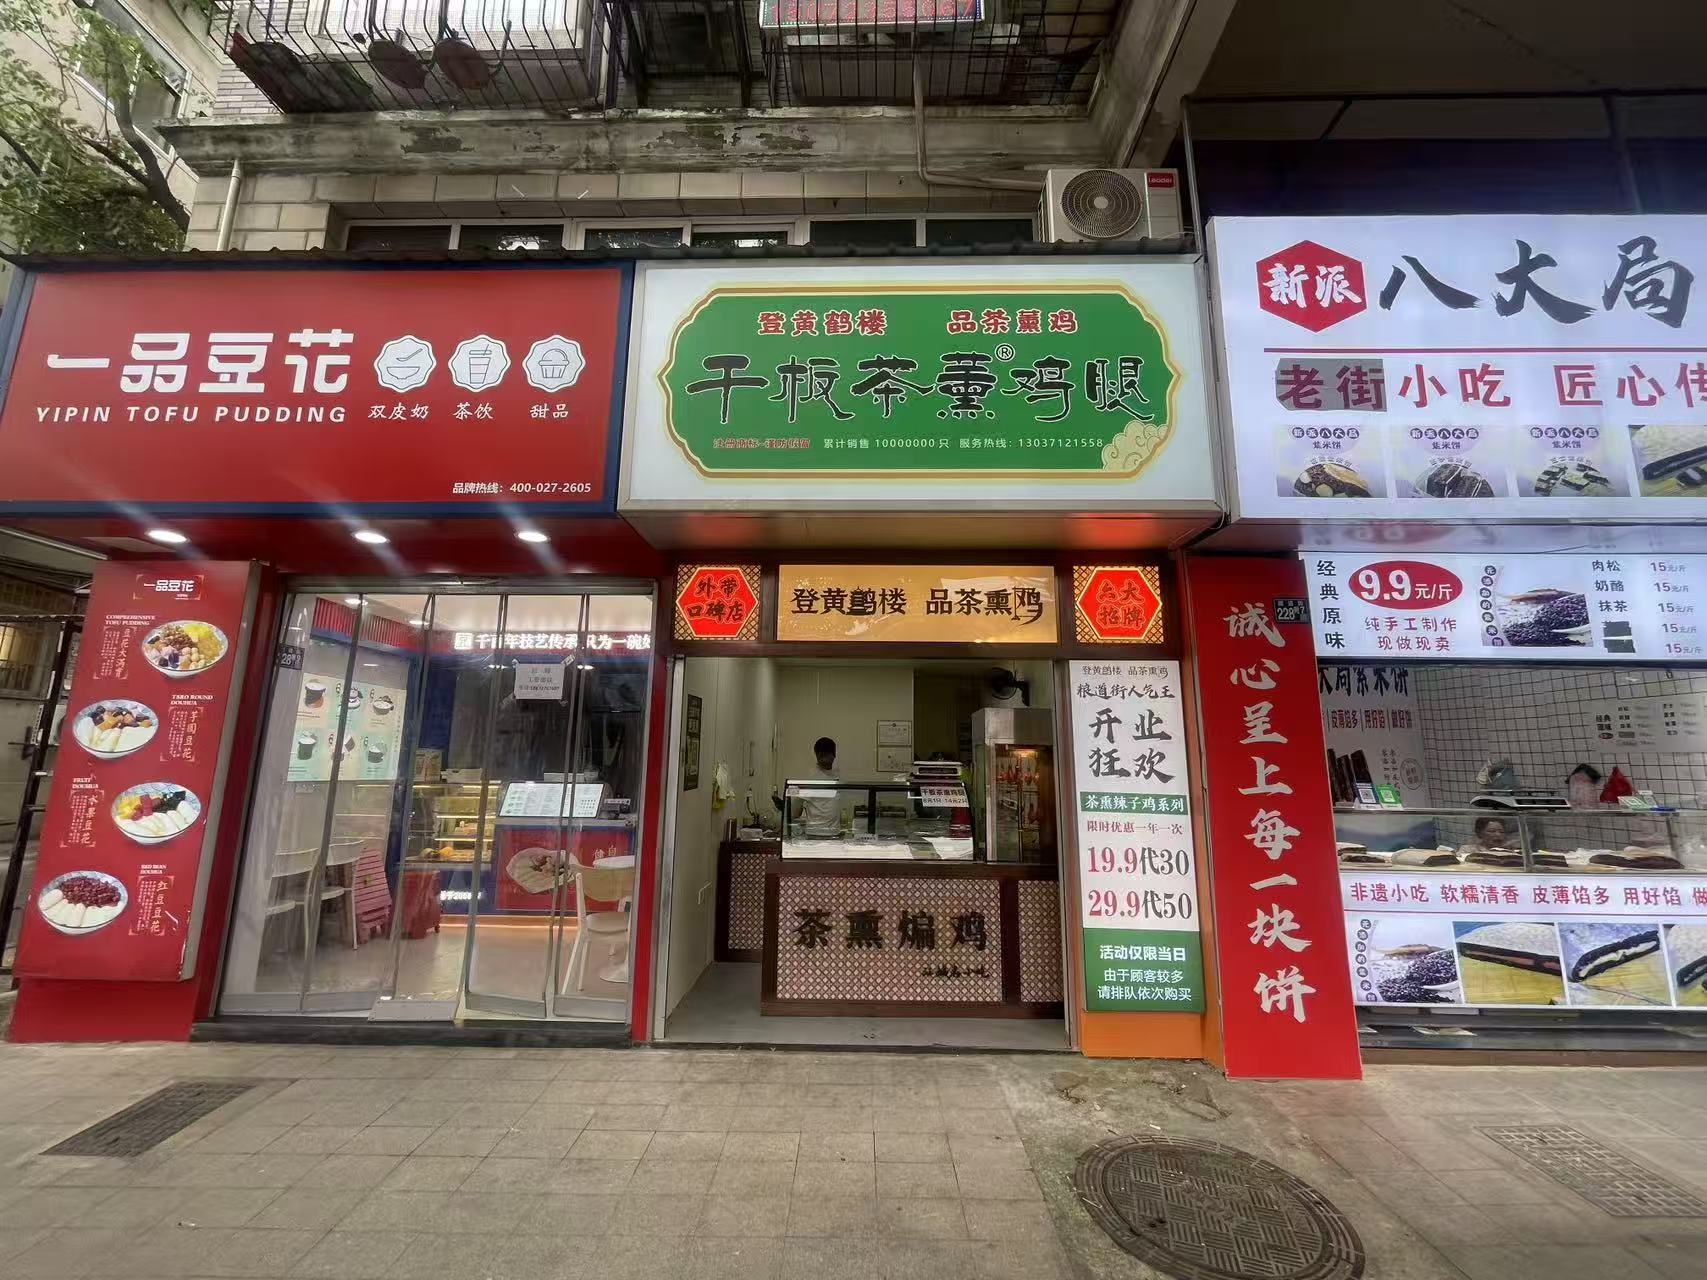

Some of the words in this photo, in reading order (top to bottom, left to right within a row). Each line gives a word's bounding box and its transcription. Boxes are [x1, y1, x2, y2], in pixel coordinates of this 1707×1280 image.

[1262, 263, 1362, 308] 新派
[1379, 235, 1694, 328] 八大局
[757, 308, 888, 336] 登黄鹤楼
[46, 328, 354, 394] 一品豆花
[1276, 362, 1512, 410] 老街小吃
[36, 406, 110, 423] YIPIN
[126, 406, 199, 423] TOFU
[215, 406, 346, 424] PUDDING
[367, 402, 429, 420] 双皮奶
[453, 402, 494, 420] 茶饮
[530, 403, 569, 419] 甜品
[1592, 560, 1620, 572] 肉松
[144, 580, 195, 591] 一品豆花
[696, 576, 738, 598] 外带
[1595, 580, 1624, 592] 奶酪
[687, 600, 744, 621] 口碑店
[1317, 560, 1345, 649] 经典原味
[1598, 601, 1628, 612] 抹茶
[1099, 605, 1143, 627] 招牌
[1365, 616, 1457, 632] 纯手工制作
[1378, 635, 1450, 651] 现做现卖
[1077, 682, 1175, 699] 粮道街人气王
[1089, 708, 1172, 744] 开业
[1088, 747, 1176, 783] 狂欢
[1085, 795, 1184, 813] 茶熏辣子鸡系列
[1223, 602, 1316, 1023] 诚心呈上每一块饼
[1087, 820, 1184, 835] 限时优惠一年一次
[1088, 846, 1190, 876] 19.9代30
[1351, 882, 1429, 902] 非遗小吃
[1440, 884, 1520, 905] 软糯清香
[1532, 885, 1610, 905] 皮薄馅多
[1624, 887, 1682, 906] 用好馅
[150, 880, 168, 932] 红豆豆花
[1089, 889, 1192, 919] 29.9代50
[1100, 945, 1186, 961] 活动仅限当日
[1104, 968, 1184, 983] 由于顾客较多
[1097, 986, 1192, 1001] 请排队依次购买
